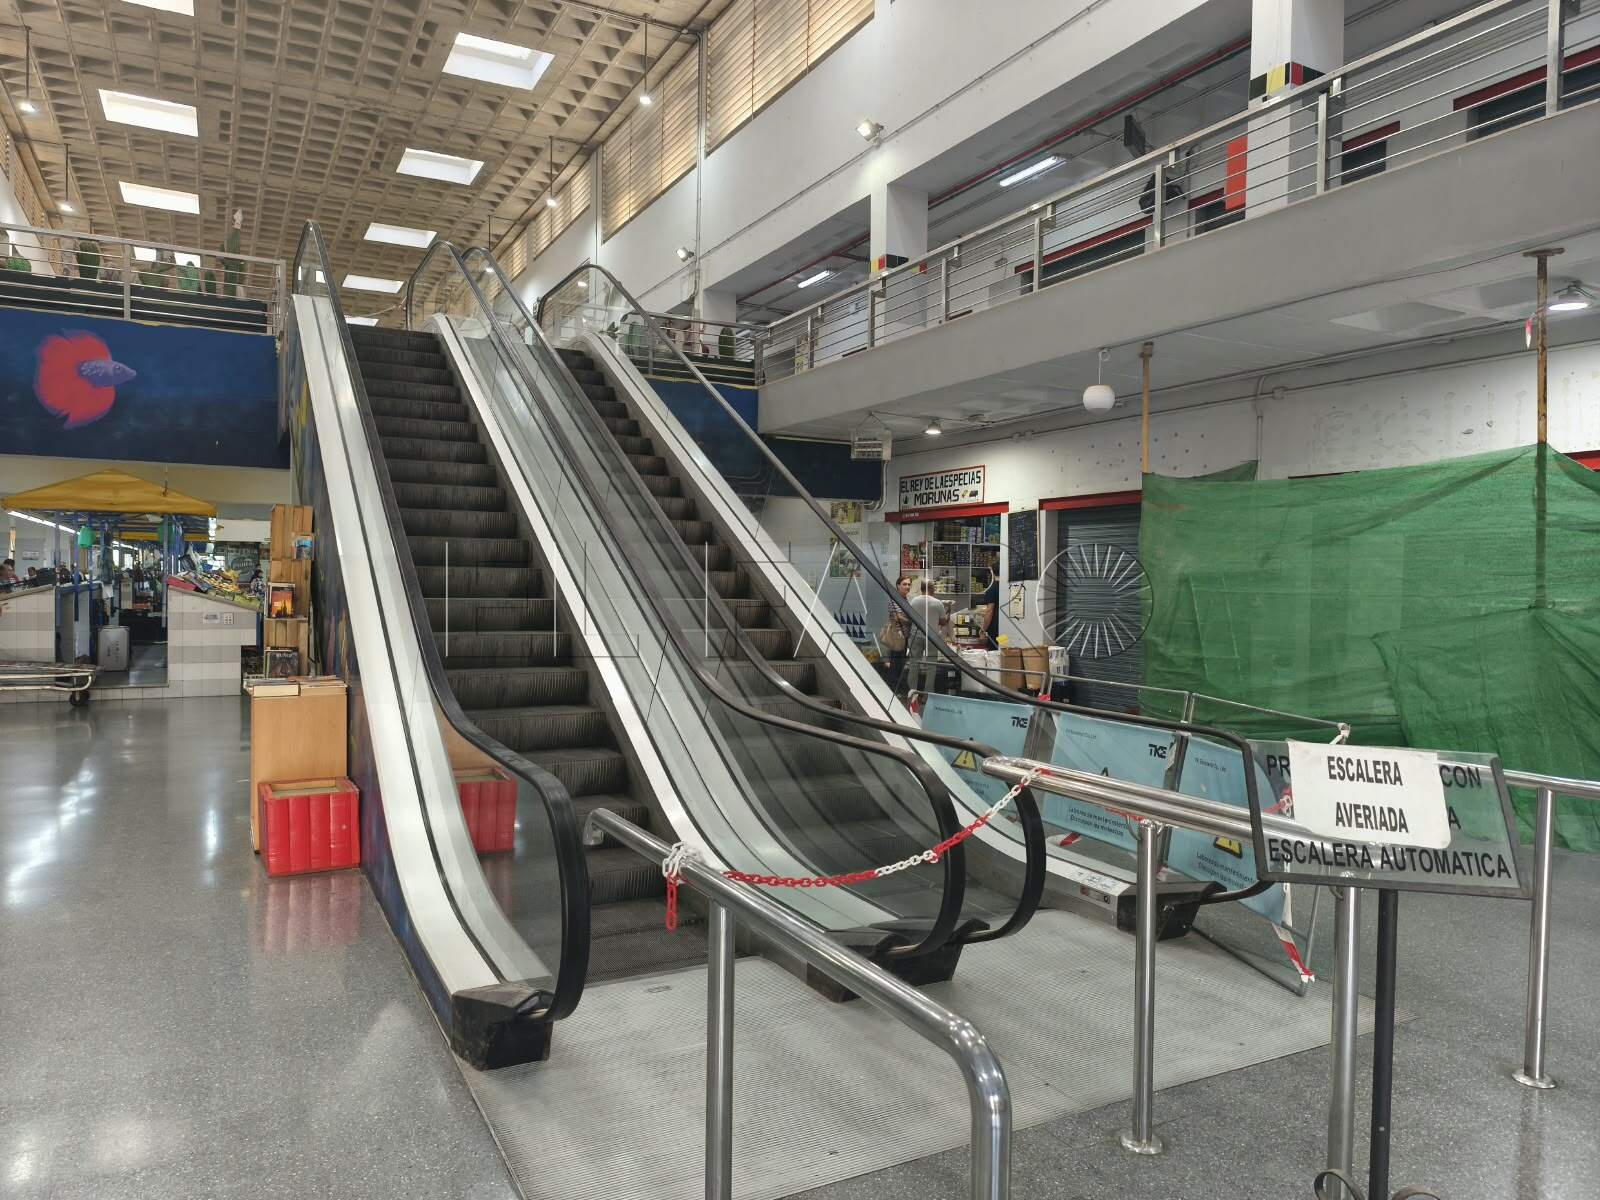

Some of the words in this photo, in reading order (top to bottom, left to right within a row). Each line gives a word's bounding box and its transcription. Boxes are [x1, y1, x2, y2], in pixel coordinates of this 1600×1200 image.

[901, 480, 910, 493] EL
[910, 478, 925, 492] REY
[925, 478, 934, 490] DE
[914, 489, 960, 506] MORUNAS
[1011, 716, 1029, 729] TKE
[1148, 743, 1167, 759] TKE
[1327, 755, 1403, 786] ESCALERA
[1440, 764, 1482, 789] CON
[1335, 801, 1409, 833] AVERIADA
[1268, 838, 1375, 869] ESCALERA
[1380, 845, 1512, 879] AUTOMATICA
